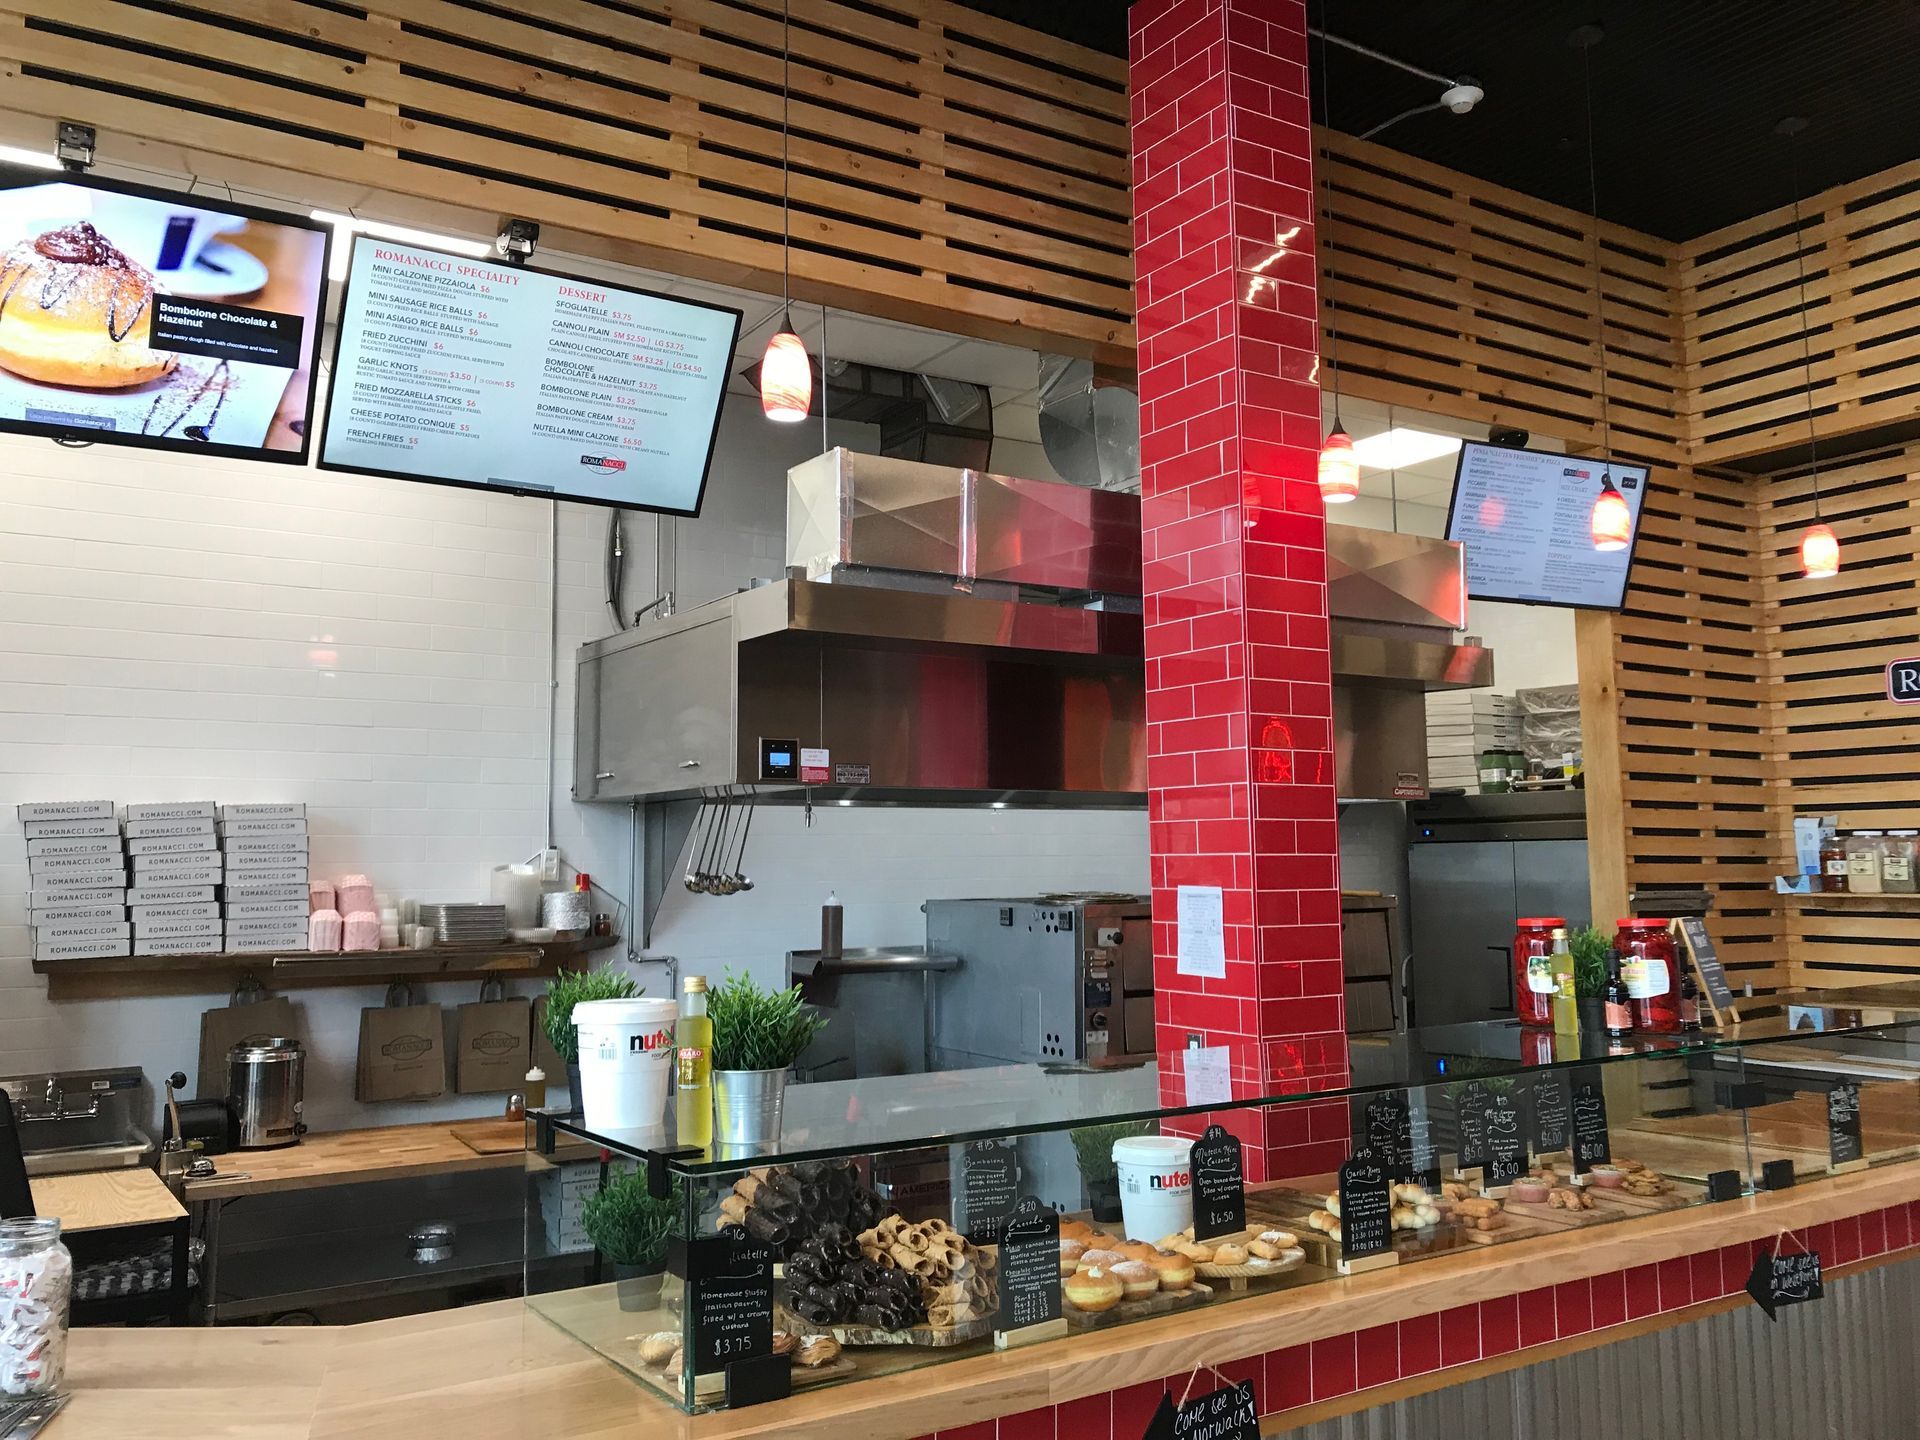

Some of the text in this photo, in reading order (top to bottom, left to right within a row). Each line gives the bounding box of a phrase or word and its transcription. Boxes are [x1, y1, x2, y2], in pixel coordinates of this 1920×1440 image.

[374, 249, 520, 286] ROMANACCI SPECIALTY
[371, 264, 490, 293] MINI CALZONE PIZZAIOLA $6
[558, 285, 607, 303] DESSERT
[367, 290, 488, 319] MINI SAUSAGE RICE BALLS $6
[555, 300, 632, 321] SFOGLIATELLE $3.75
[158, 312, 203, 328] Hazelnut
[159, 301, 277, 329] Bombolone Chocolate &
[365, 309, 478, 336] MINI ASIAGO RICE BALLS $6
[362, 329, 444, 350] FRIED ZUCCHINI $6
[551, 319, 684, 351] CANNOLI PLAIN SM $2.50 LG $3.75
[548, 338, 702, 373] CANNOLI CHOCOLATE SM $3.25 LG $4.50
[544, 357, 595, 372] BOMBOLONE
[358, 356, 388, 367] GARLIC
[389, 361, 418, 372] KNOTS
[449, 371, 471, 381] $3.50
[504, 380, 515, 388] $5
[543, 364, 658, 391] CHOCOLATE & HAZELNUT $3.75
[354, 381, 476, 407] FRIED MOZZARELLA STICKS $6
[540, 383, 636, 406] BOMBOLONE PLAIN $3.25
[350, 407, 470, 431] CHEESE POTATO CONIQUE $5
[536, 403, 636, 425] BOMBOLONE CREAM $3.75
[347, 428, 419, 445] FRENCH FRIES $5
[532, 423, 642, 446] NUTELLA MINI CALZONE $6.50
[581, 455, 625, 469] ROMANACCI
[1898, 669, 1920, 692] R
[33, 806, 100, 815] ROMANACCI.COM
[140, 810, 202, 818] ROMANACCI.COM
[139, 826, 201, 834] ROMANACCI.COM
[237, 823, 295, 831] ROMANACCI.COM
[41, 845, 107, 853] ROMANACCI.COM
[142, 843, 204, 852] ROMANACCI.COM
[237, 843, 296, 851] ROMANACCI.COM
[44, 857, 111, 867] ROMANACCI.COM
[148, 856, 210, 865] ROMANACCI.COM
[47, 876, 113, 885] ROMANACCI.COM
[148, 873, 210, 881] ROMANACCI.COM
[238, 873, 296, 881] ROMANACCI.COM
[47, 893, 113, 902] ROMANACCI.COM
[140, 891, 202, 900] ROMANACCI.COM
[240, 889, 298, 897] ROMANACCI.COM
[45, 910, 112, 919] ROMANACCI.COM
[145, 908, 208, 917] ROMANACCI.COM
[240, 905, 299, 913] ROMANACCI.COM
[51, 927, 117, 936] ROMANACCI.COM
[148, 924, 210, 933] ROMANACCI.COM
[239, 922, 297, 930] ROMANACCI.COM
[50, 944, 117, 953] ROMANACCI.COM
[149, 941, 211, 950] ROMANACCI.COM
[237, 939, 296, 947] ROMANACCI.COM
[1019, 1201, 1036, 1214] #20
[1210, 1211, 1233, 1225] $6.50
[714, 1335, 752, 1356] $3.75
